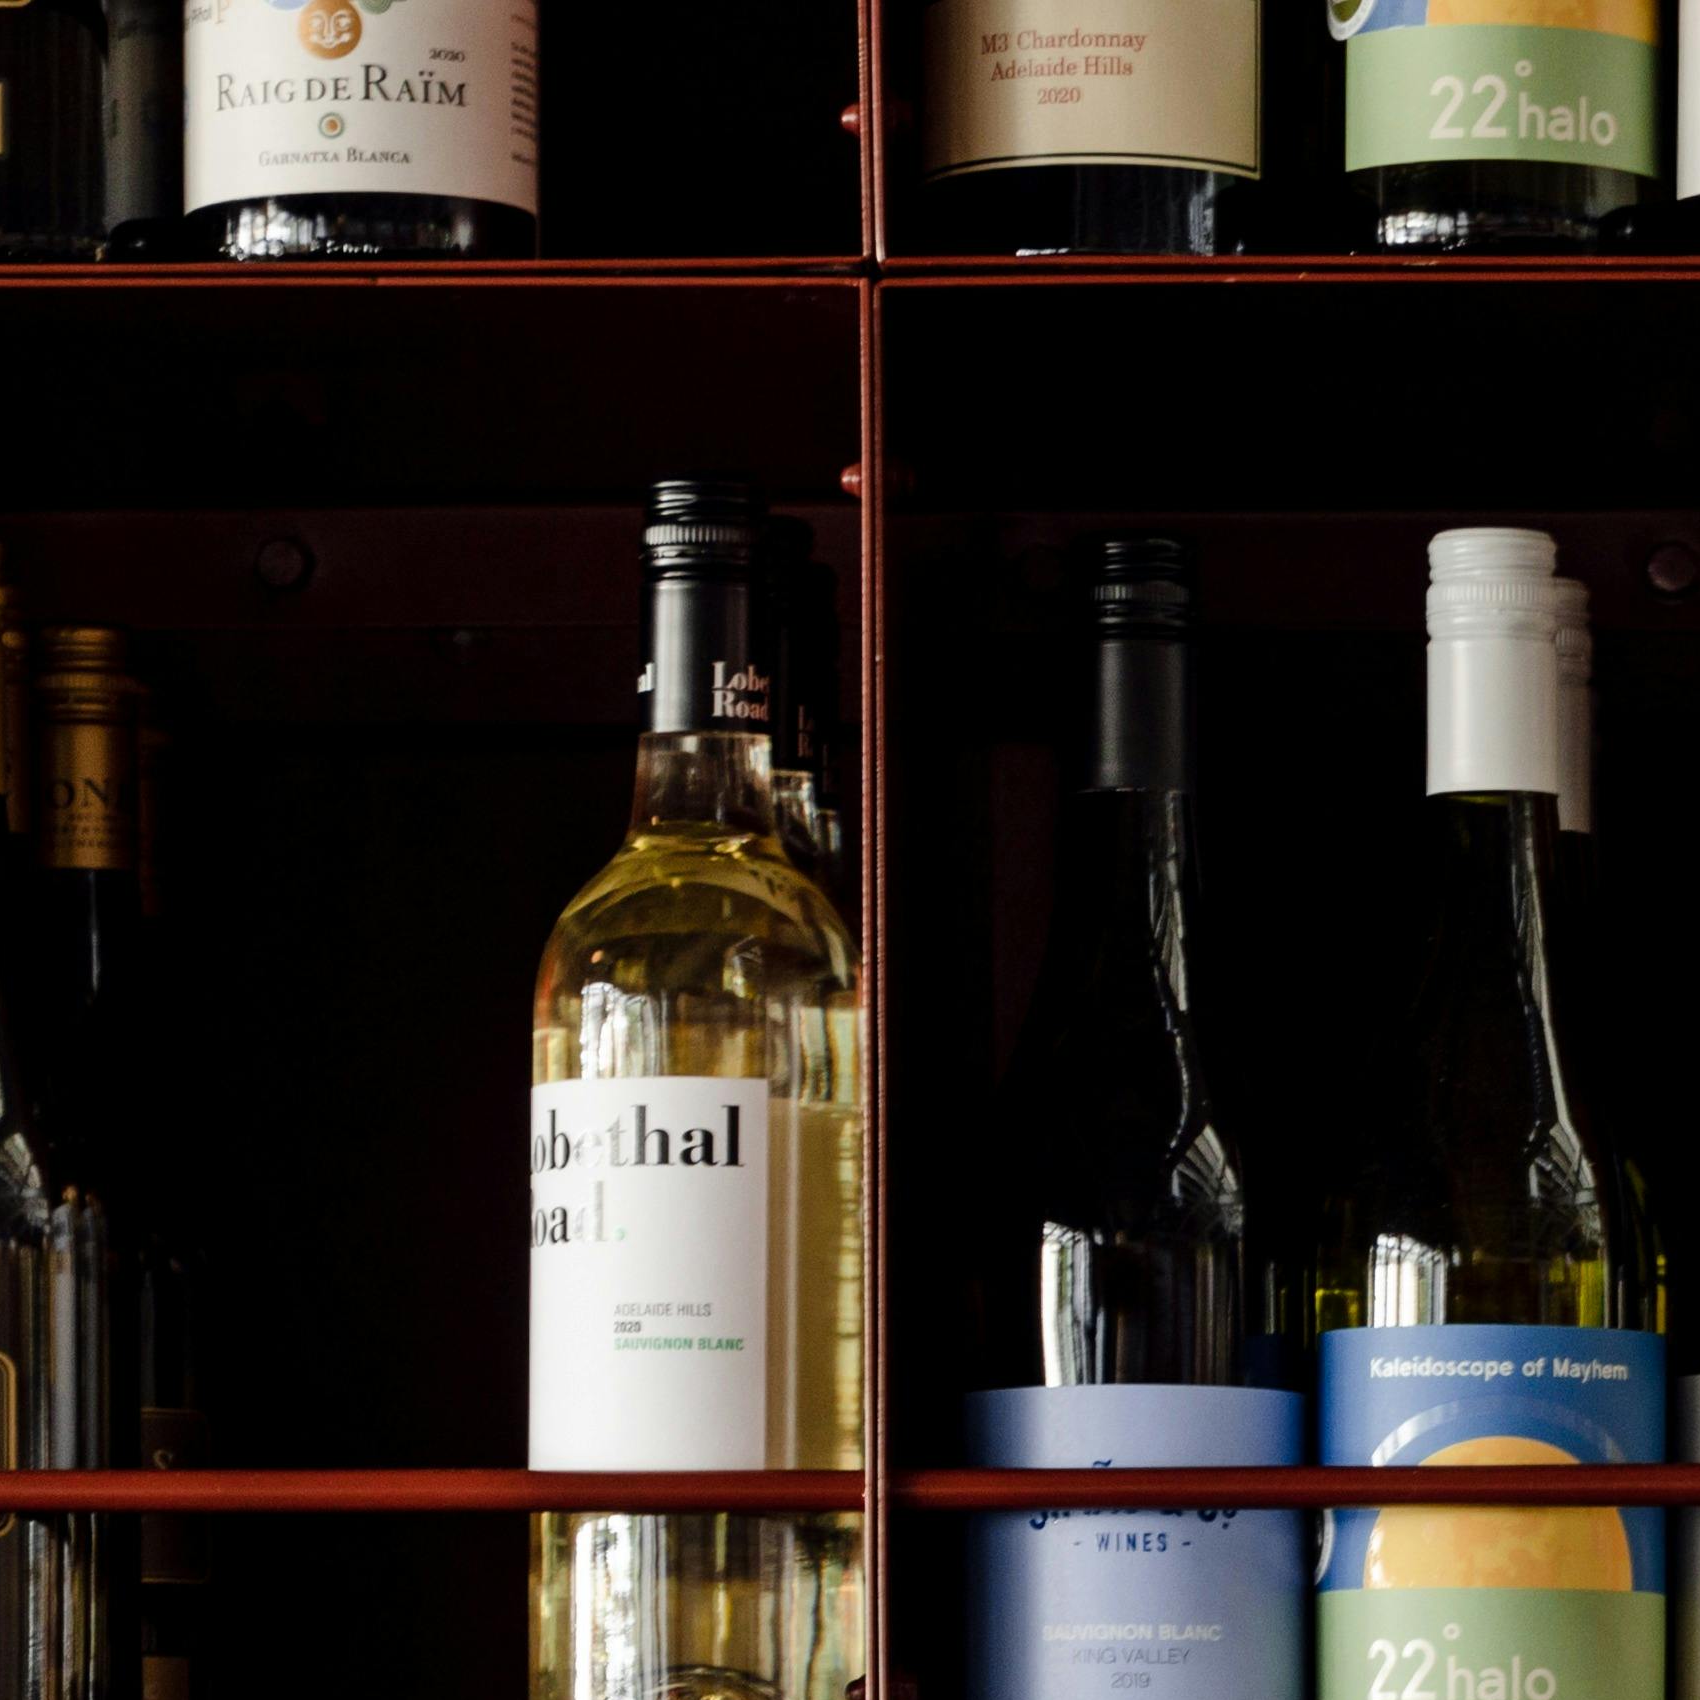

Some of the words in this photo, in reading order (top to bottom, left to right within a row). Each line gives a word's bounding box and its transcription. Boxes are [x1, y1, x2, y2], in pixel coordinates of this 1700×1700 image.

[981, 32, 1009, 54] M3
[1016, 28, 1147, 52] Chardonnay
[429, 47, 465, 62] 2020
[991, 57, 1077, 81] Adelaide
[1083, 55, 1133, 77] Hills
[1037, 86, 1080, 105] 2020
[613, 1303, 673, 1317] ADELAIDE
[677, 1302, 712, 1317] HILLS
[613, 1321, 642, 1334] 2020
[613, 1337, 693, 1351] SAUVIGNON
[697, 1337, 745, 1351] BLANC
[1370, 1355, 1513, 1381] Kaleidoscope
[1522, 1357, 1545, 1377] of
[1553, 1357, 1628, 1384] Mayhem
[1095, 1532, 1169, 1553] WINES
[1042, 1623, 1152, 1641] SAUVIGNON
[1159, 1623, 1223, 1641] BLANC
[1071, 1648, 1116, 1665] KING
[1122, 1648, 1190, 1665] VALLEY
[1111, 1671, 1151, 1689] 2019
